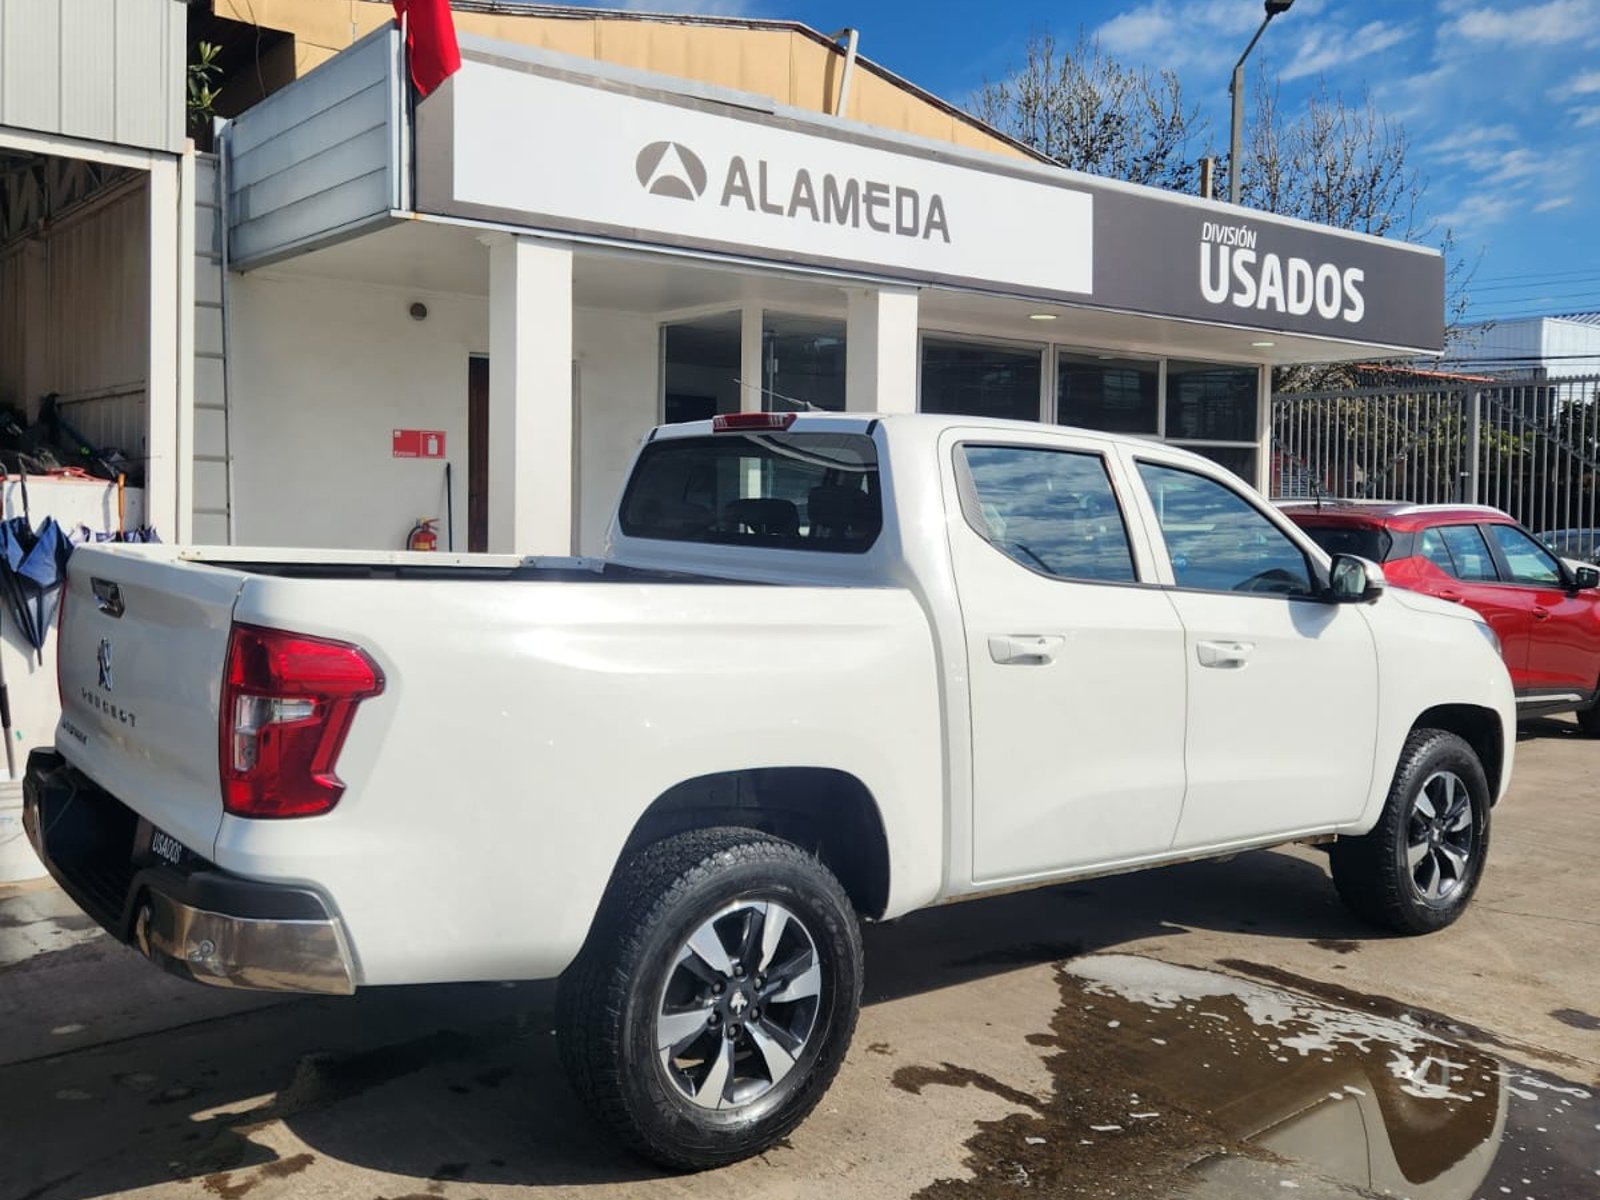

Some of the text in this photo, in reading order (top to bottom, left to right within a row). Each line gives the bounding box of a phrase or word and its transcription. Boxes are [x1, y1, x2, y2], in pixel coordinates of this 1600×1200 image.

[720, 155, 951, 243] ALAMEDA
[1201, 222, 1257, 249] DIVISIÓN
[1200, 242, 1365, 323] USADOS
[152, 832, 182, 864] USADOS
